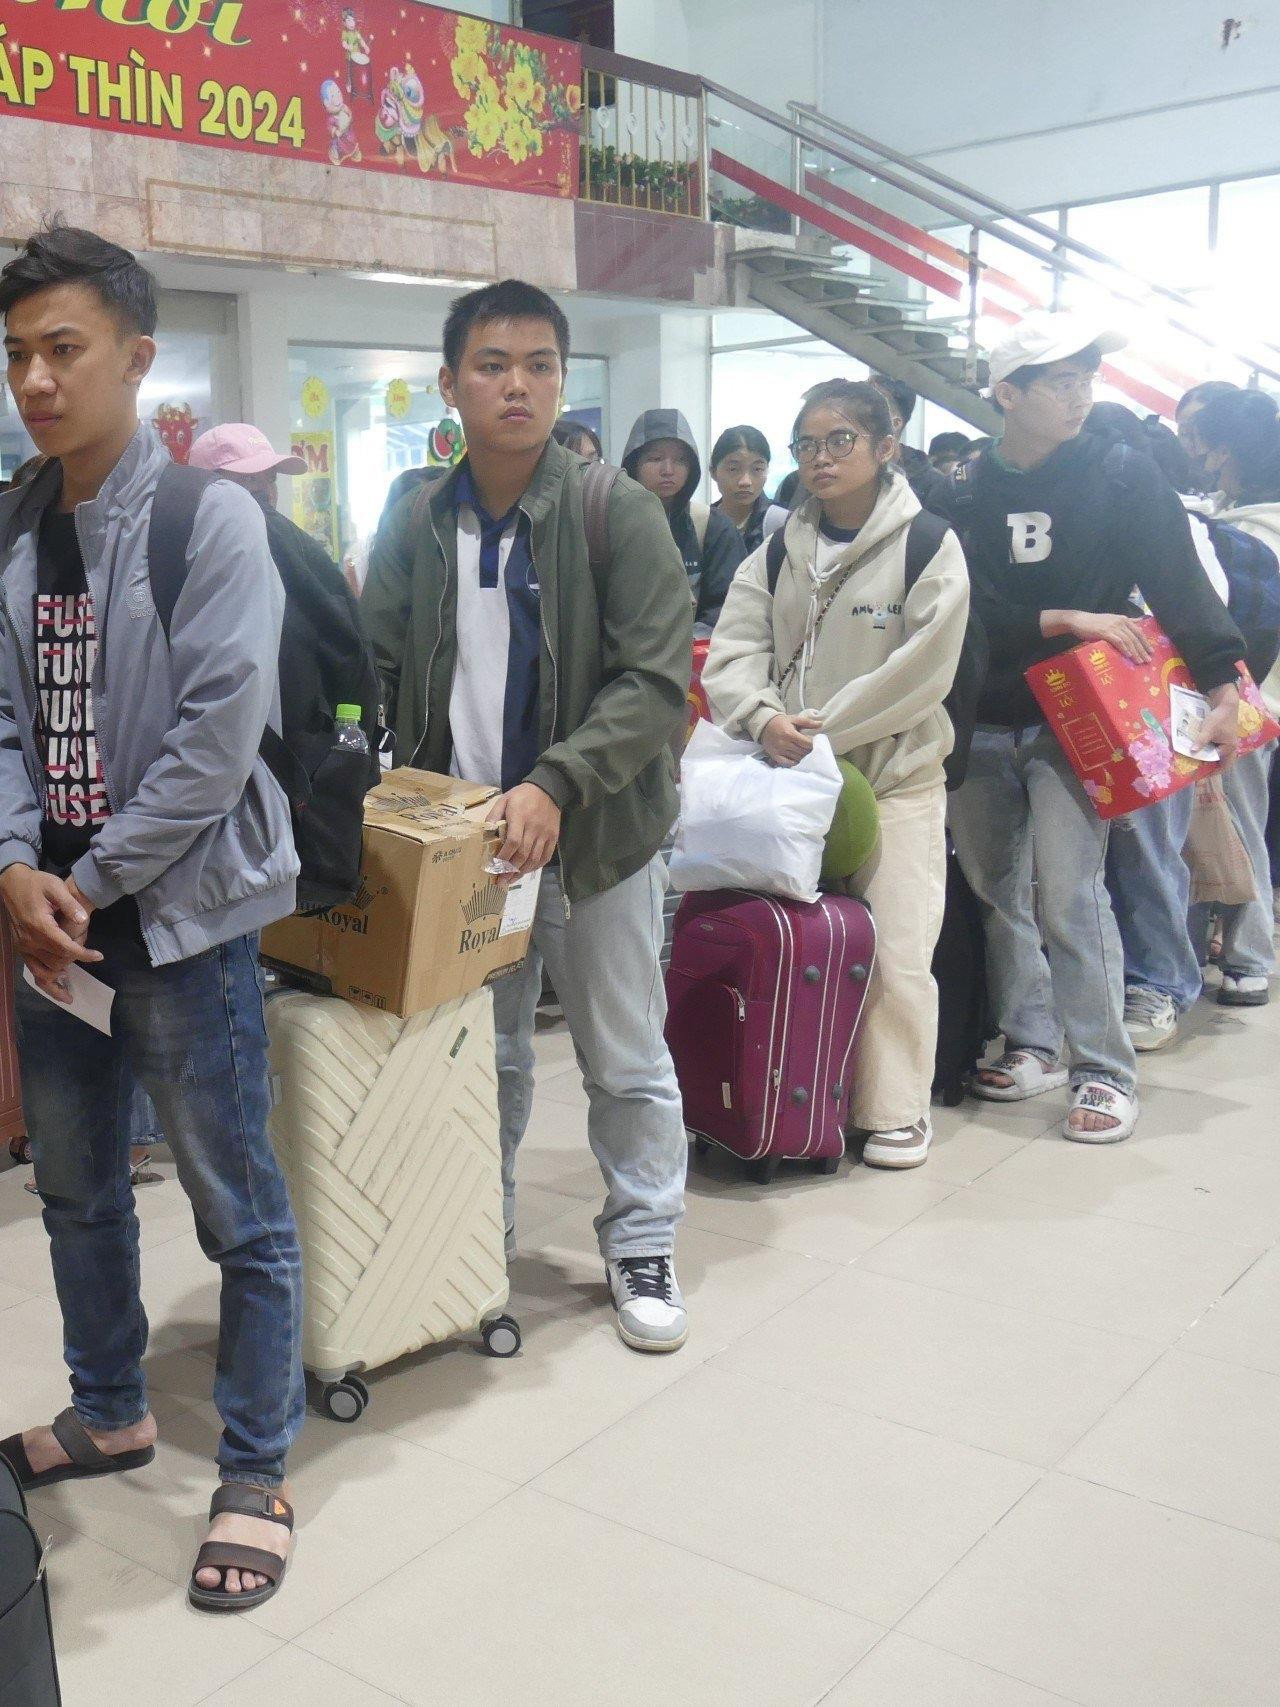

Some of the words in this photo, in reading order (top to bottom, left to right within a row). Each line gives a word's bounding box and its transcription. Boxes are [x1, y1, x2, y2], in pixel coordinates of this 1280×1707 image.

[68, 48, 183, 130] THÌN
[199, 79, 307, 148] 2024
[1006, 511, 1052, 564] B
